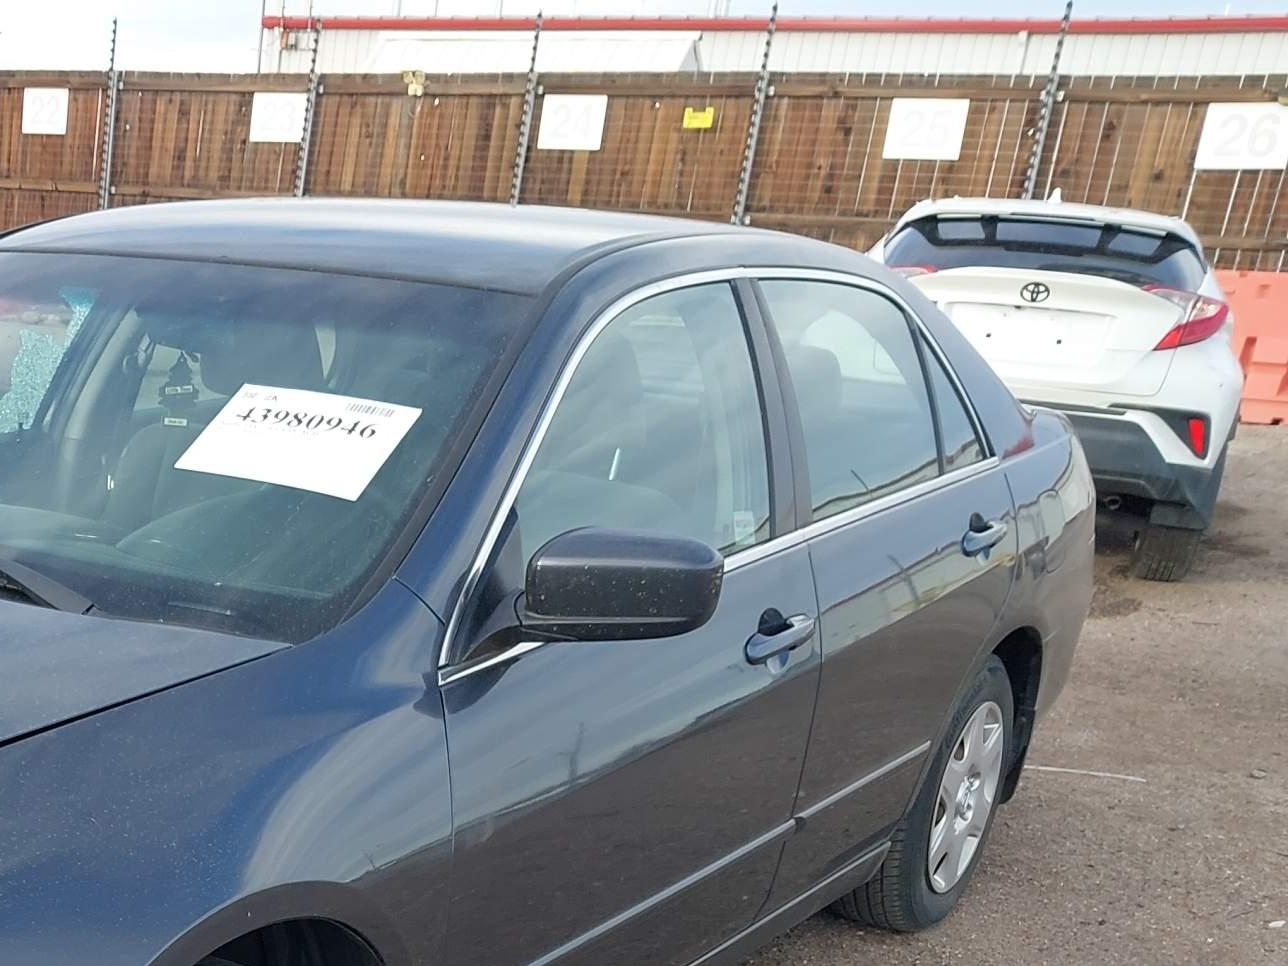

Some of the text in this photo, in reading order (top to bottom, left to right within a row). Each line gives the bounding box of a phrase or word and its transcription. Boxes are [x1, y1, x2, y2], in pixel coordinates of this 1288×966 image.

[30, 95, 61, 126] 22
[549, 102, 594, 140] 24
[897, 108, 953, 149] 25
[1212, 112, 1282, 159] 26
[235, 406, 378, 439] 43980946
